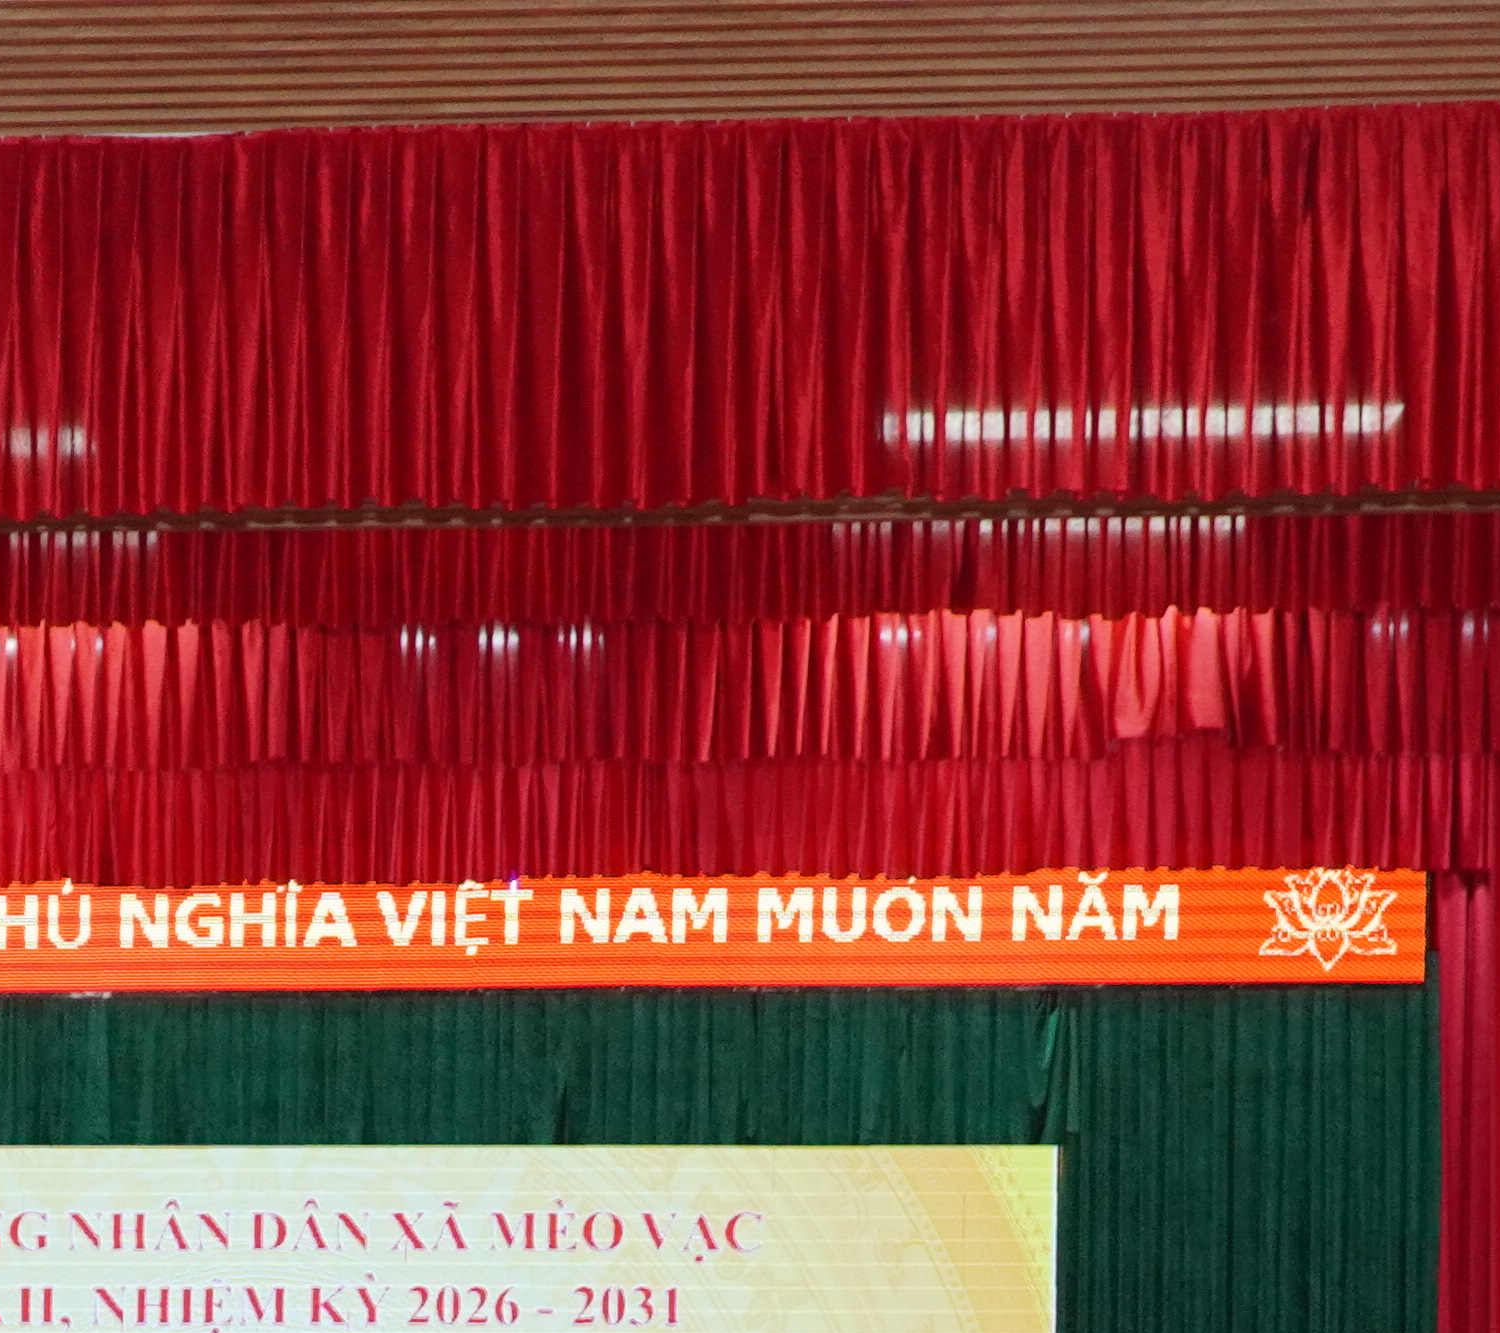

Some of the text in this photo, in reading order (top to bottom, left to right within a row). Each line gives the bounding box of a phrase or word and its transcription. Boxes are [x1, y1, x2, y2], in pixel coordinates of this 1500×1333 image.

[376, 880, 534, 956] VIỆT
[559, 887, 730, 944] NAM
[1011, 870, 1180, 942] NĂM
[67, 1198, 232, 1253] NHÂN
[249, 1198, 372, 1253] DÂN
[390, 1200, 471, 1253] XÃ
[489, 1197, 624, 1253] MÈO
[640, 1209, 764, 1263] VẠC
[309, 1270, 391, 1328] KỲ
[406, 1285, 521, 1328] 2026
[572, 1285, 681, 1328] 2031
